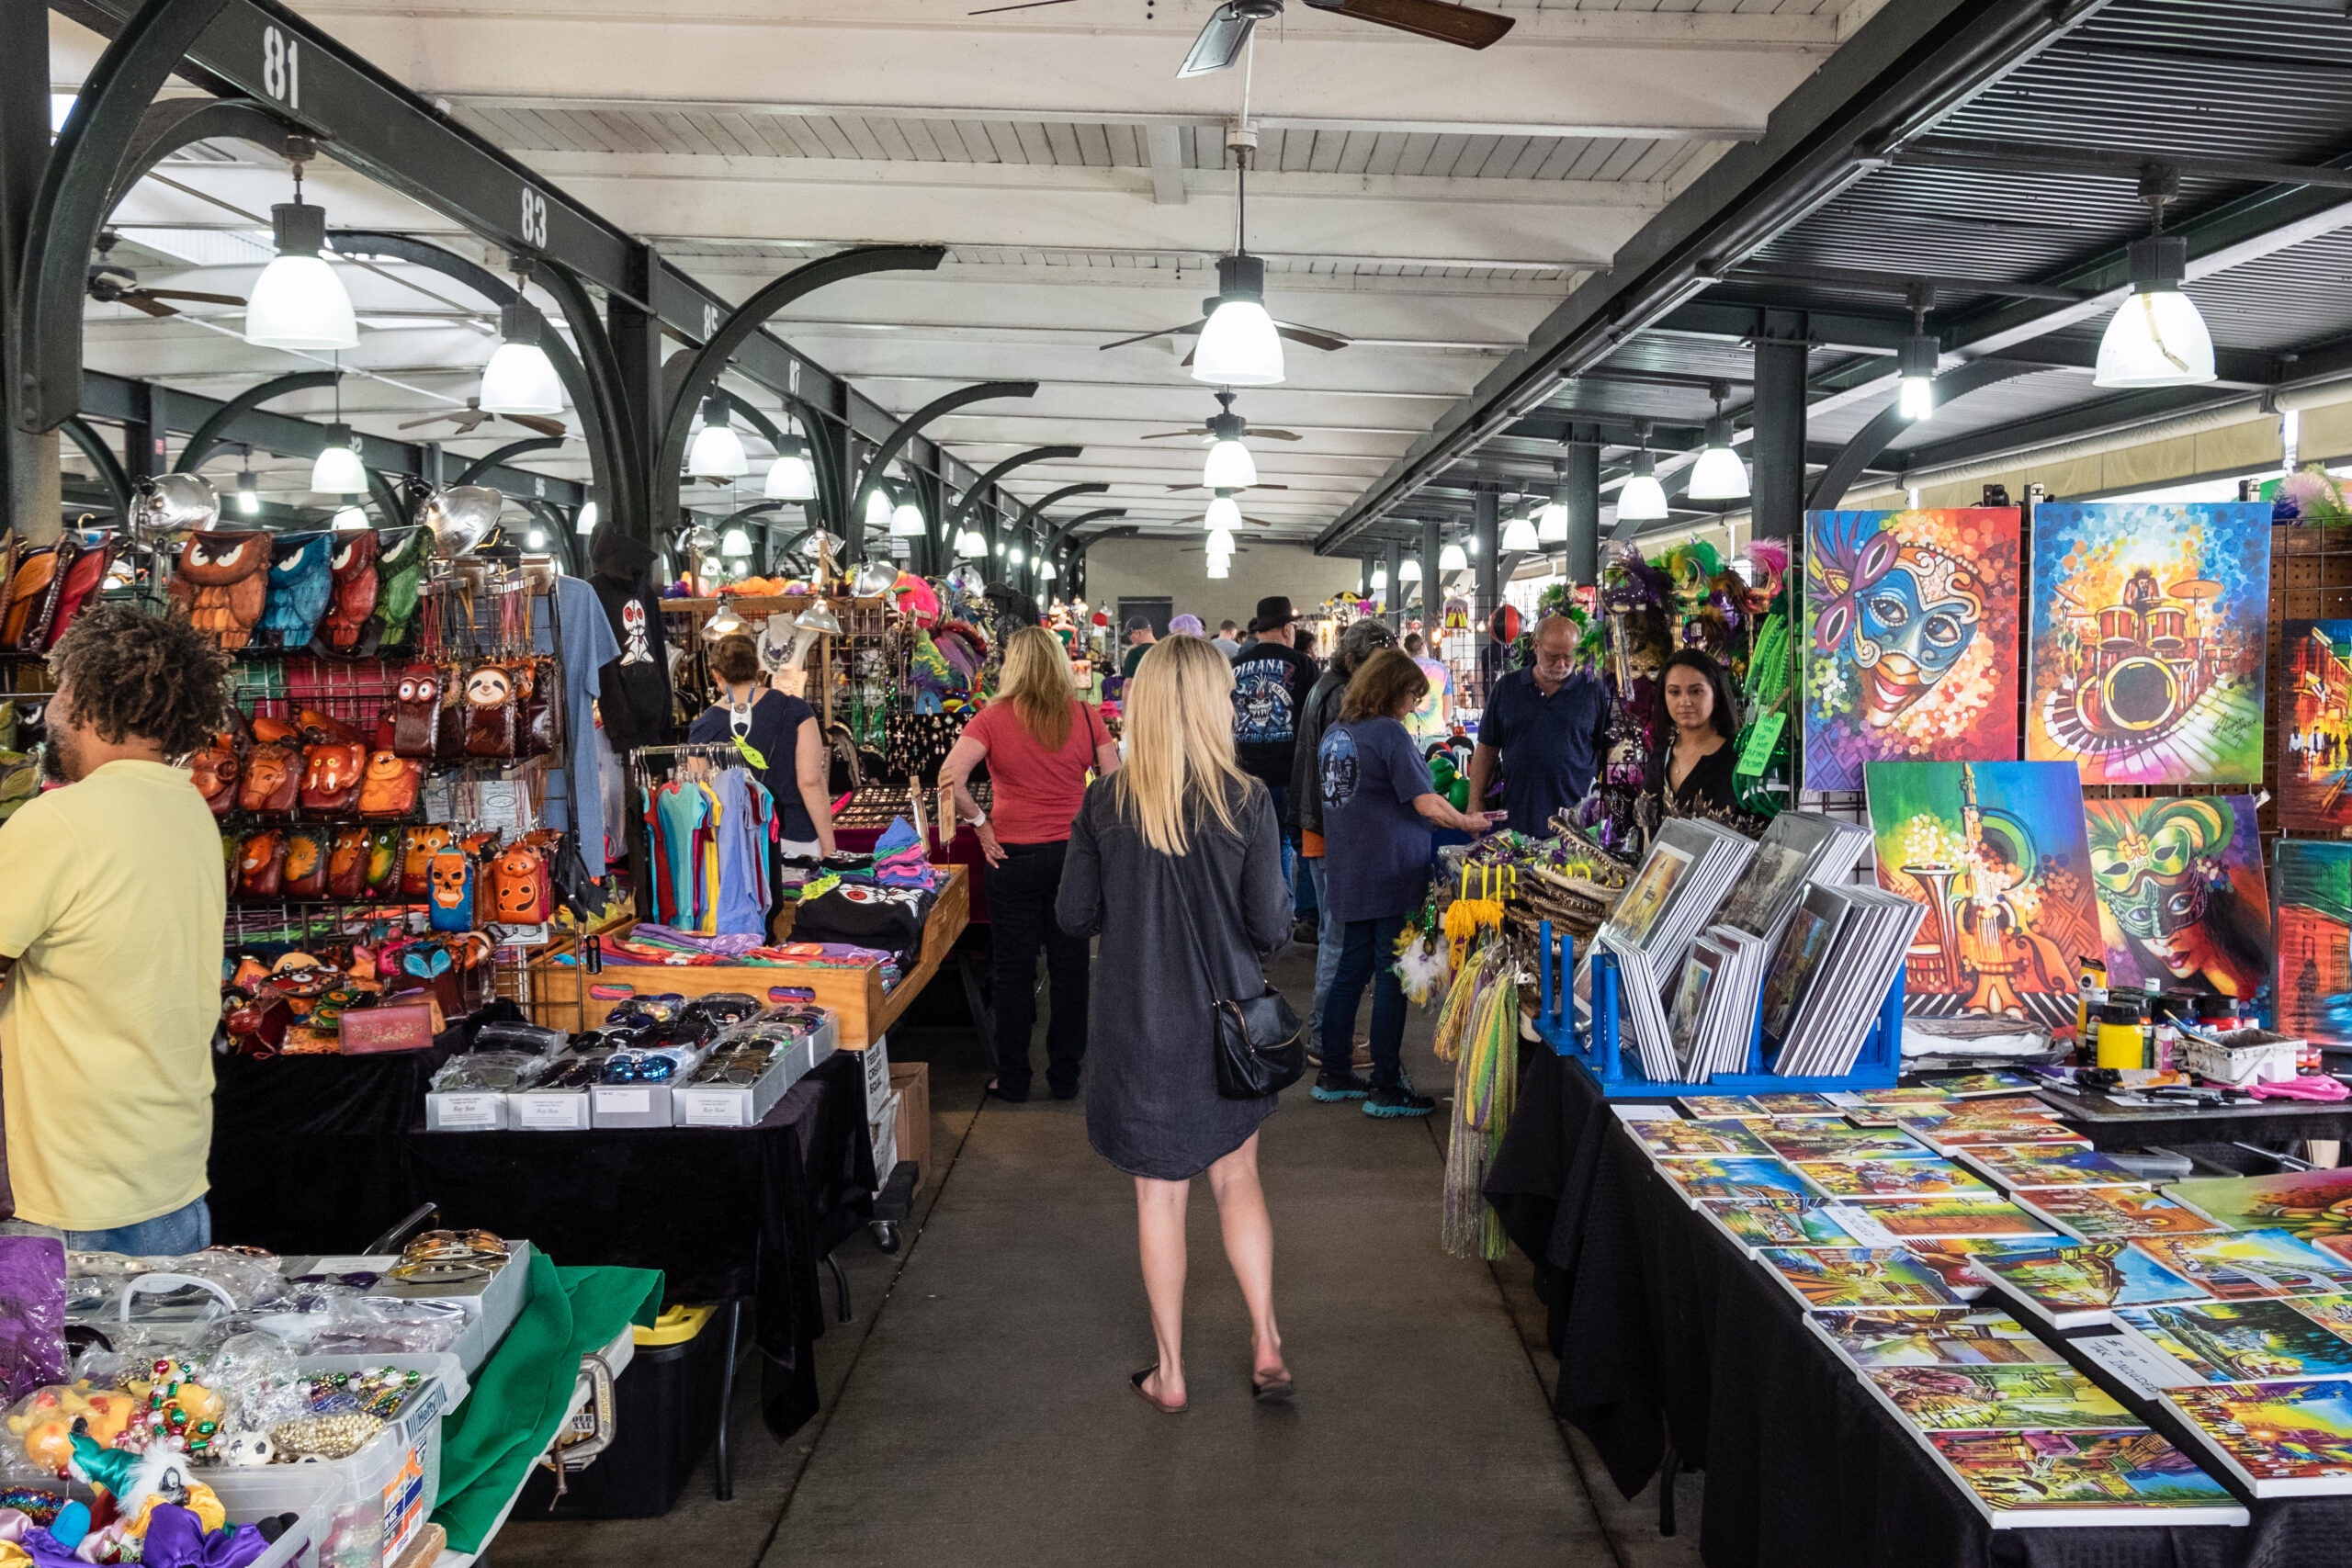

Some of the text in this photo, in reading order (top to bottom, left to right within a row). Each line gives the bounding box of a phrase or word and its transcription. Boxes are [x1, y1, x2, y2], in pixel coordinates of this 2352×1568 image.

[264, 26, 299, 109] 81
[522, 187, 547, 249] 83
[1264, 731, 1295, 743] SPEED
[417, 1397, 438, 1426] Hefty
